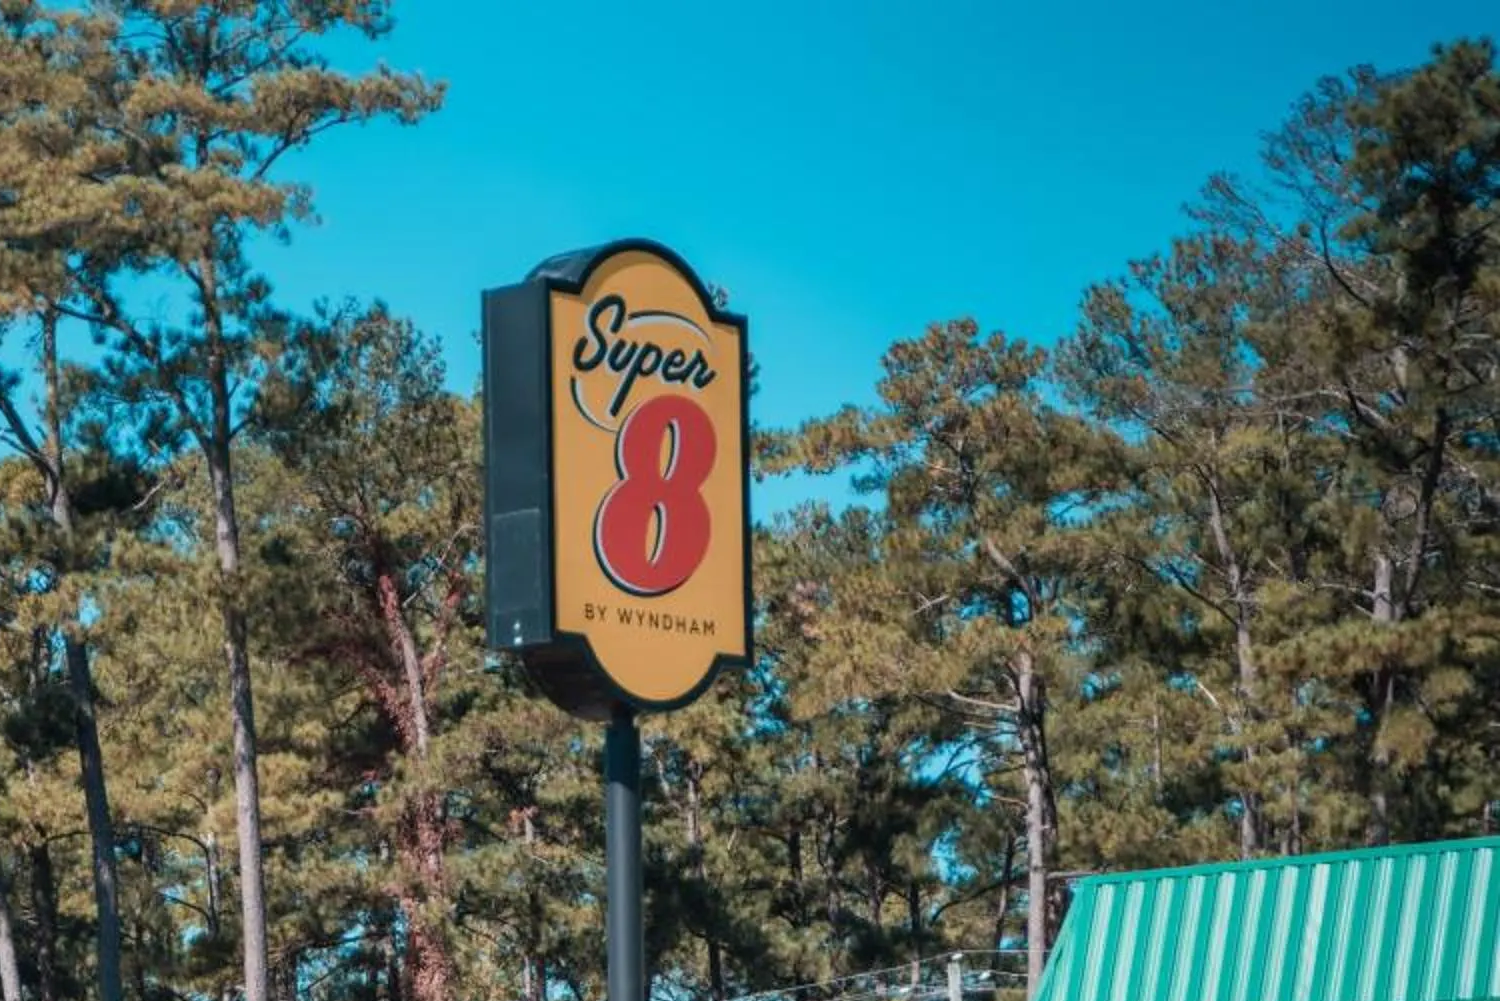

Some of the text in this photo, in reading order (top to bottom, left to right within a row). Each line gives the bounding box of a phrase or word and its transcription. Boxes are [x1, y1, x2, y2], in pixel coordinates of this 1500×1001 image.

[572, 294, 717, 417] Super
[592, 394, 718, 598] 8
[584, 602, 716, 636] BY WYNDHAM
